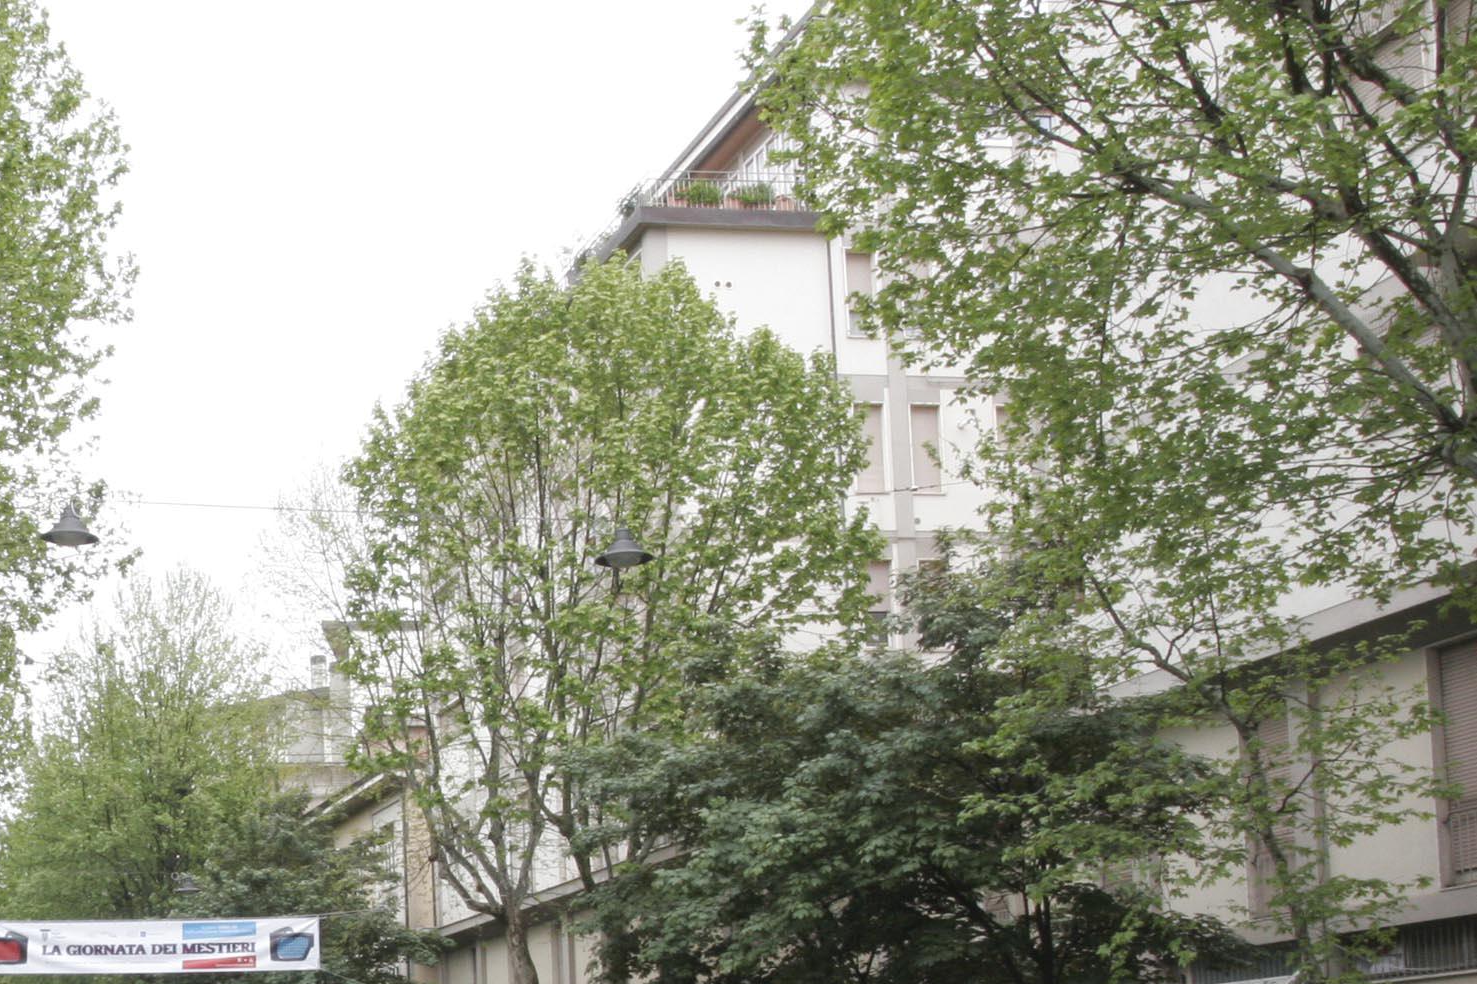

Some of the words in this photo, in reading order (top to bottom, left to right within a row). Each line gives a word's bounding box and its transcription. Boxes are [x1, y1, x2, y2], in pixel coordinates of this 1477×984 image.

[42, 944, 62, 956] LA
[66, 943, 146, 956] GIORNATA
[151, 943, 177, 955] DEI
[182, 942, 256, 955] MESTIERI
